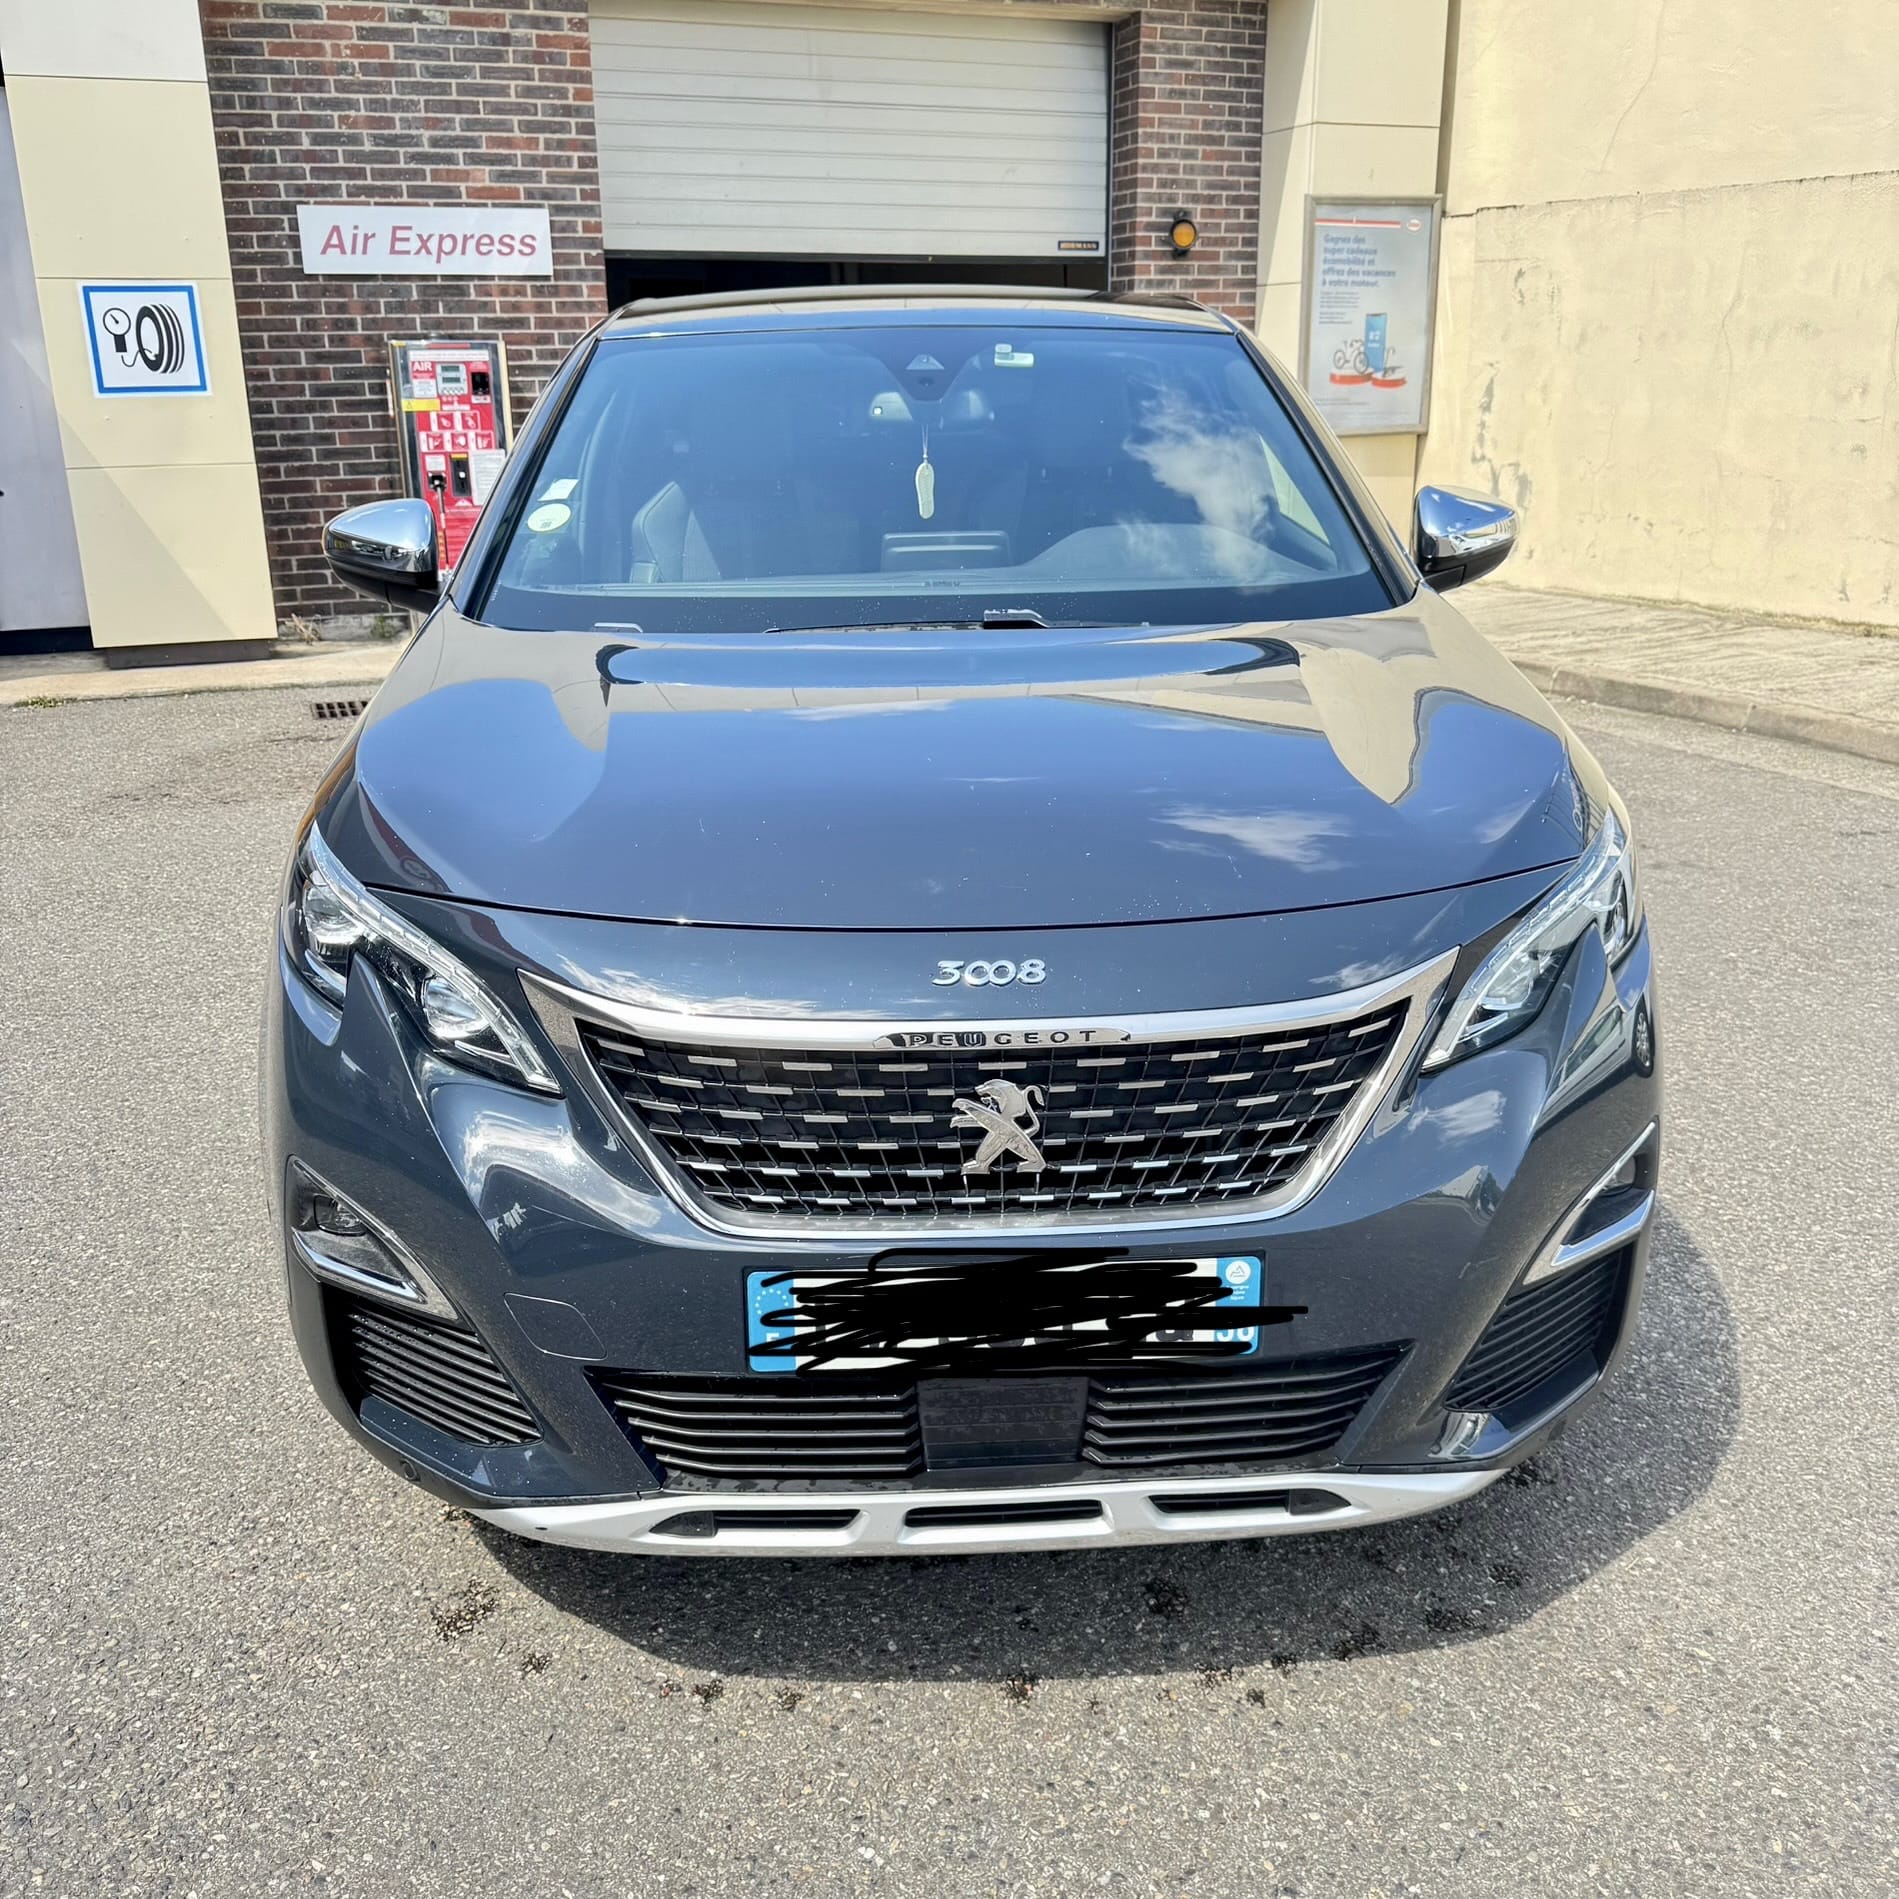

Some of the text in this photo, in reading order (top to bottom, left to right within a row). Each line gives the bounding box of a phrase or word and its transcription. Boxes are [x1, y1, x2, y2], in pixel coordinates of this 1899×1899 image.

[320, 224, 537, 264] Air Express
[413, 361, 433, 371] AIR
[931, 959, 1047, 986] 3008
[908, 1030, 1097, 1048] PEUGEOT
